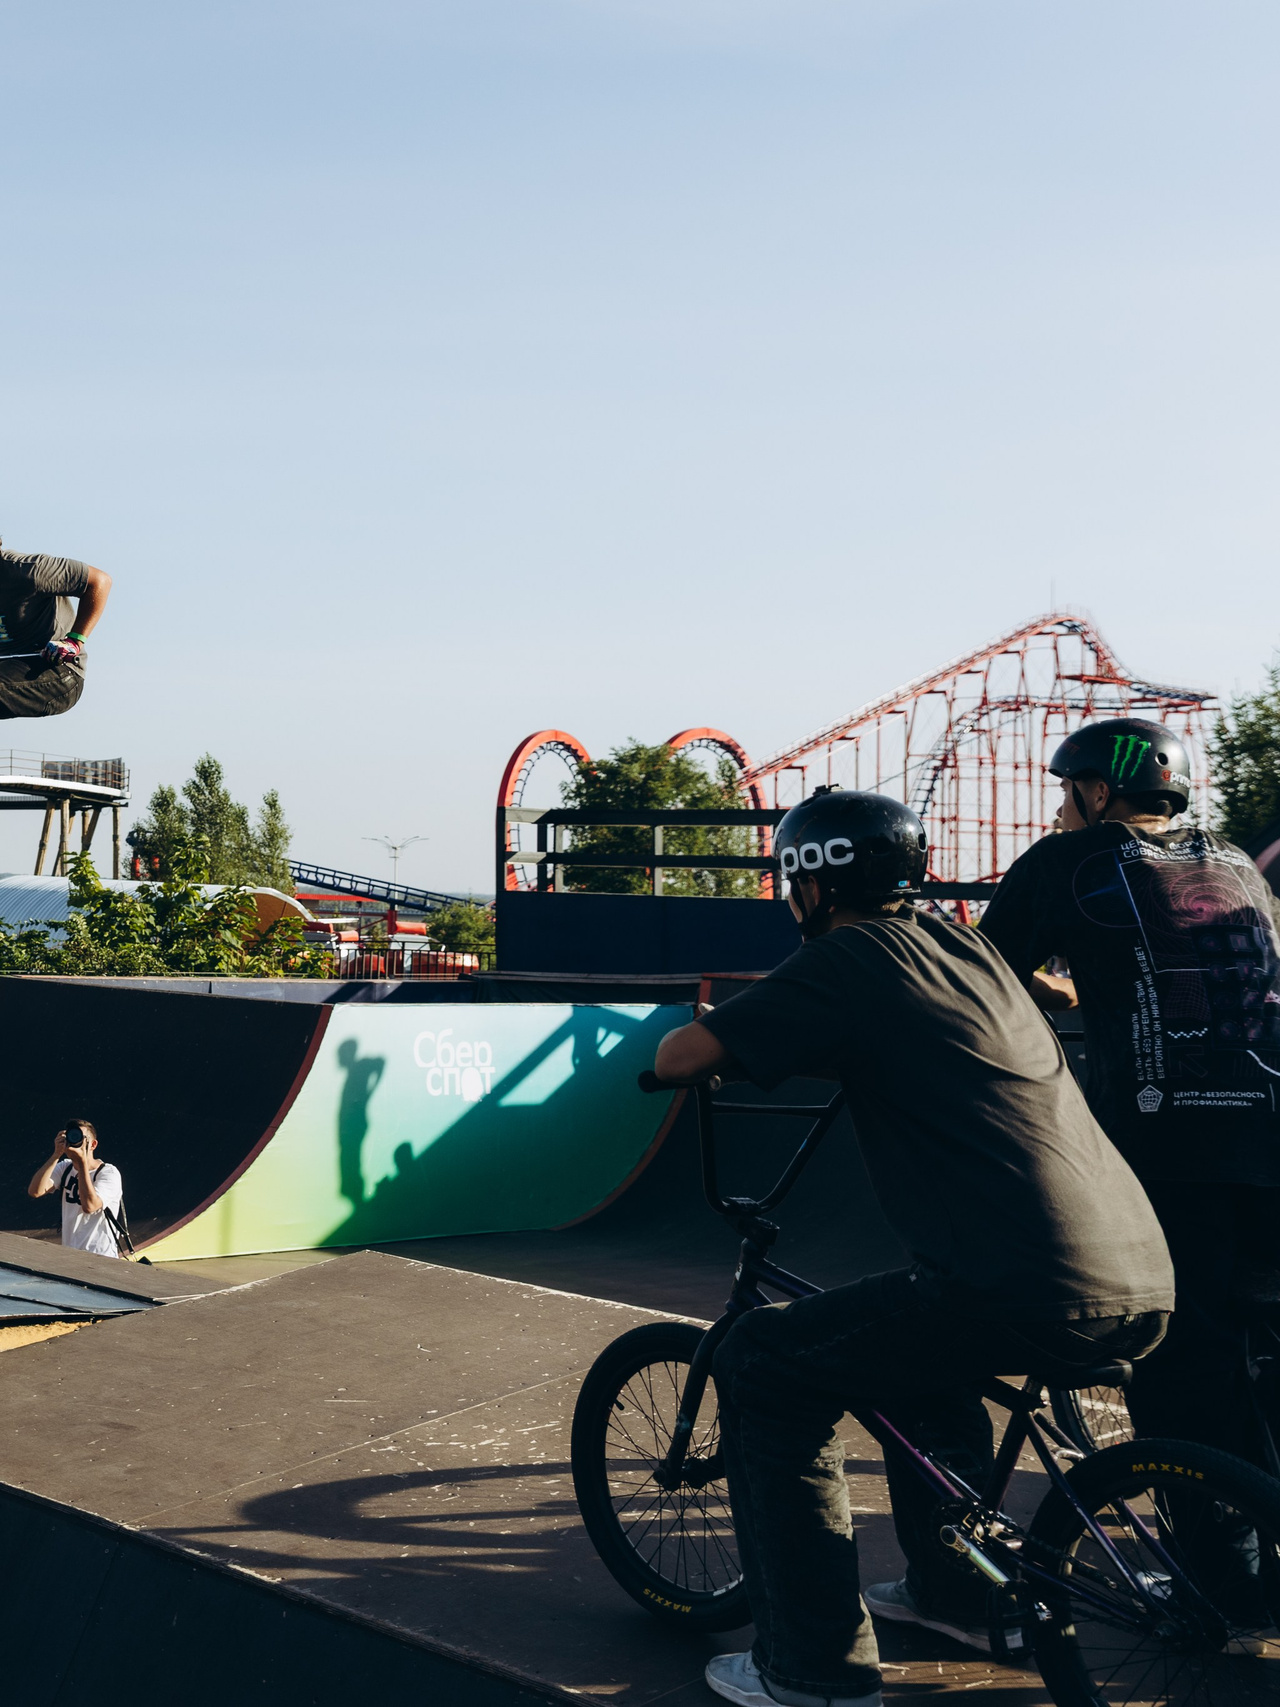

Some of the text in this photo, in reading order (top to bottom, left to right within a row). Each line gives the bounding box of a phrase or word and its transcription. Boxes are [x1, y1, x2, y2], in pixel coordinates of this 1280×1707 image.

[1145, 973, 1154, 985] НЕ
[1148, 987, 1160, 1018] НИКУДА
[1152, 1020, 1161, 1032] ОН
[413, 1028, 493, 1068] Сбер
[1154, 1034, 1165, 1080] ВЕРОЯТНО
[1173, 1091, 1200, 1099] ЦЕНТР
[1131, 1462, 1205, 1480] MAXXIS
[642, 1587, 692, 1613] MAXXIS
